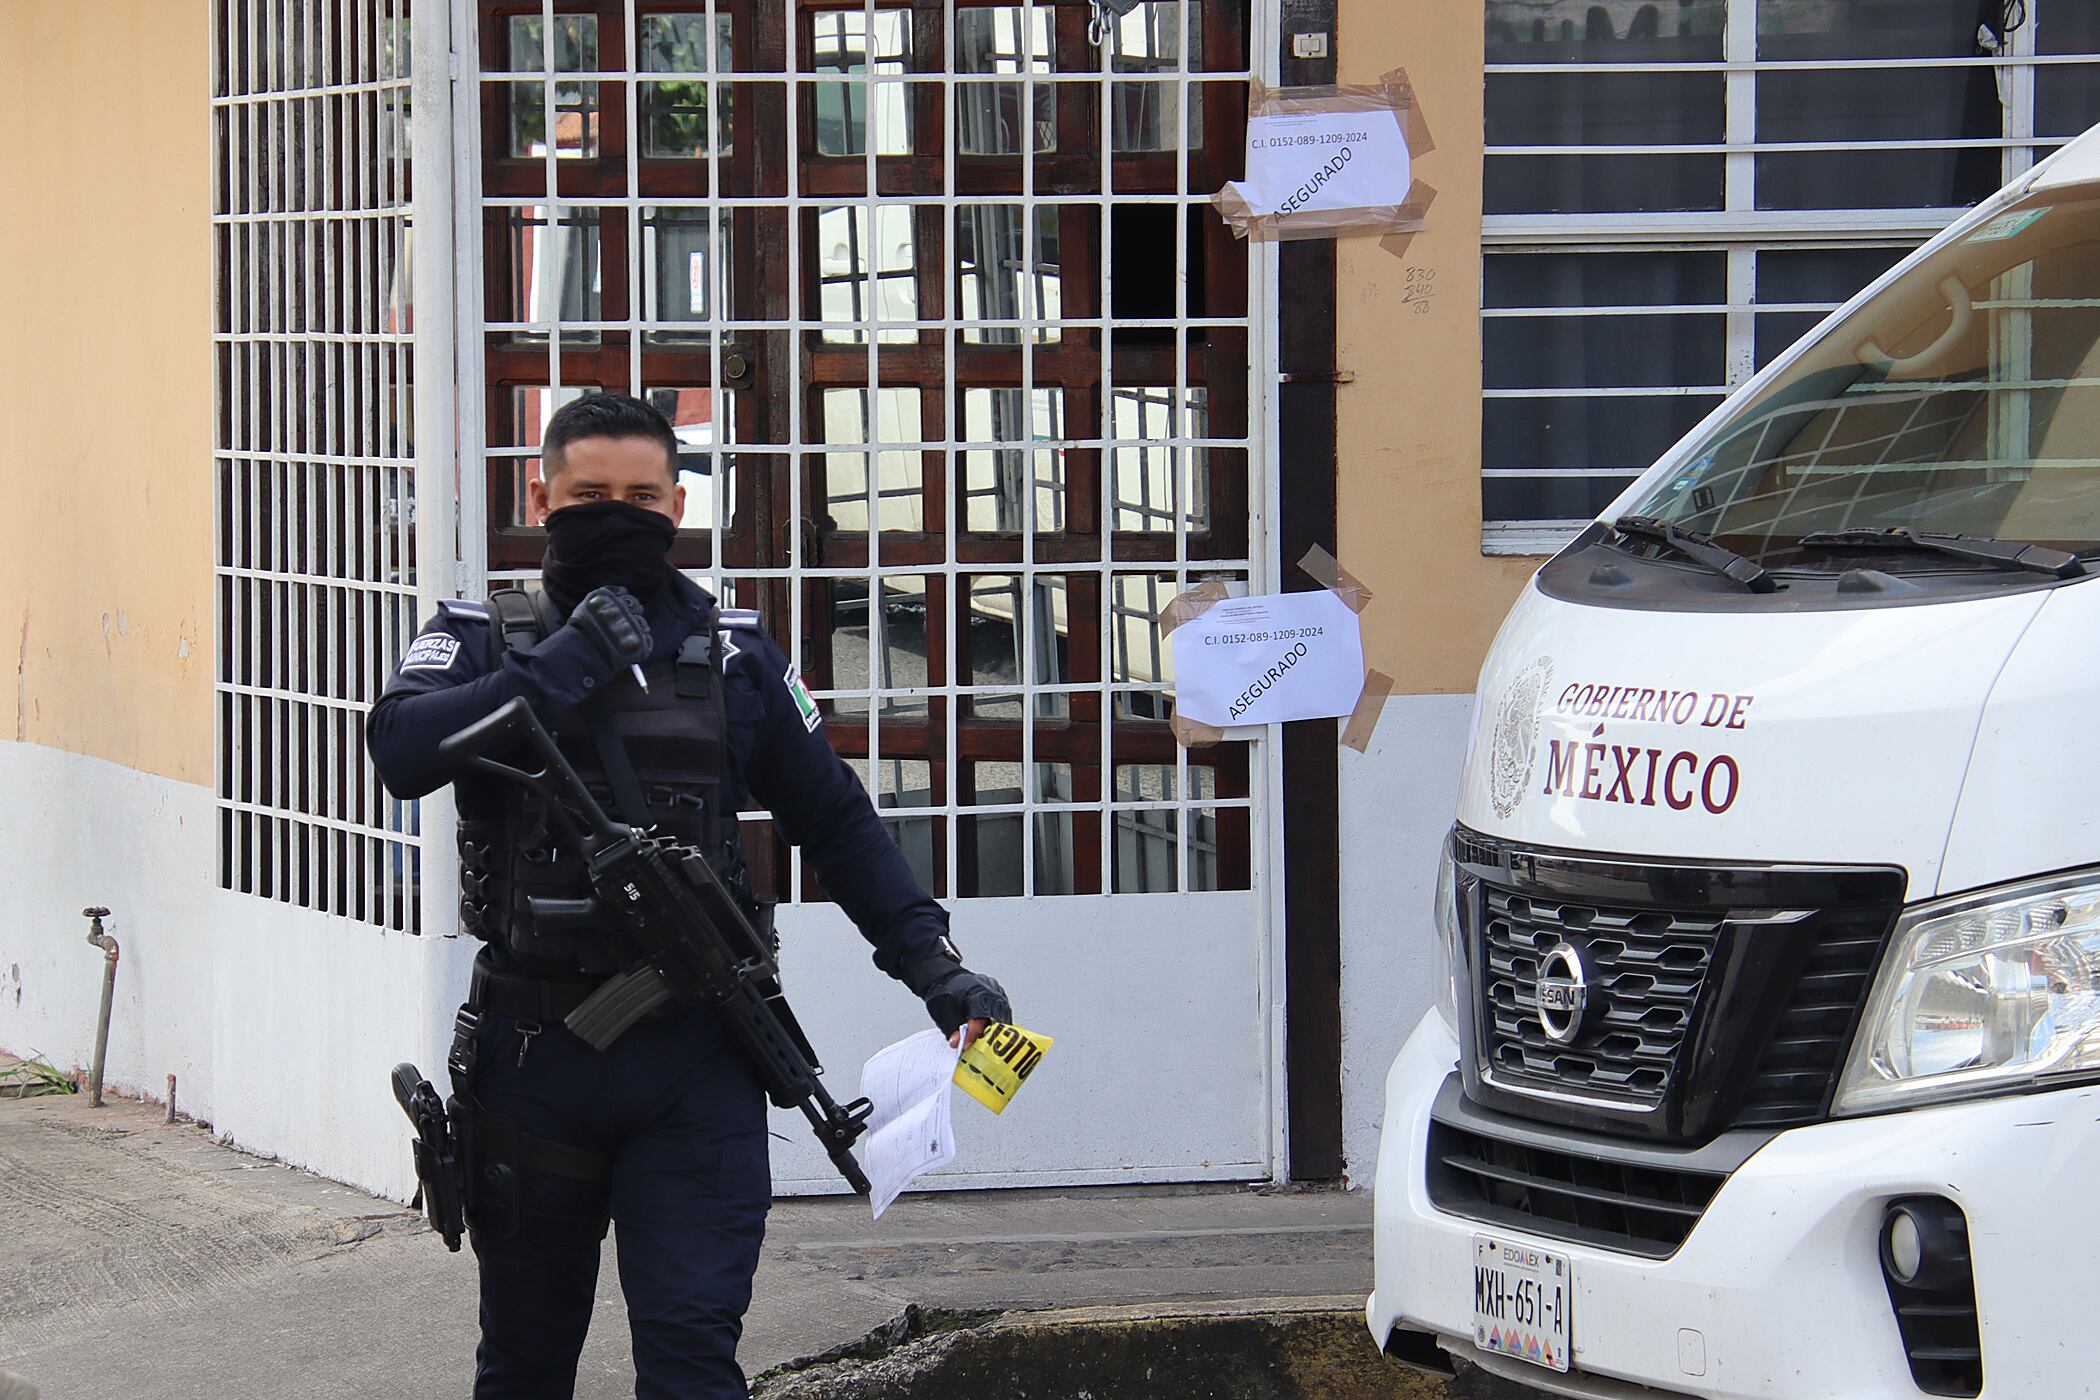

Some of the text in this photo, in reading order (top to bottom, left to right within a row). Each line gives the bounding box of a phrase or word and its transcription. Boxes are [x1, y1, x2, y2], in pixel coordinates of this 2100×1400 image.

[1251, 132, 1368, 149] C.I. 0152-089-1209-2024
[1273, 147, 1353, 224] ASEGURADO
[1204, 626, 1324, 646] C.I. 0152-089-1209-2024
[1229, 642, 1308, 721] ASEGURADO
[1557, 682, 1754, 729] GOBIERNO DE
[1543, 722, 1740, 815] MÉXICO
[1475, 1265, 1563, 1336] MXH-651-A
